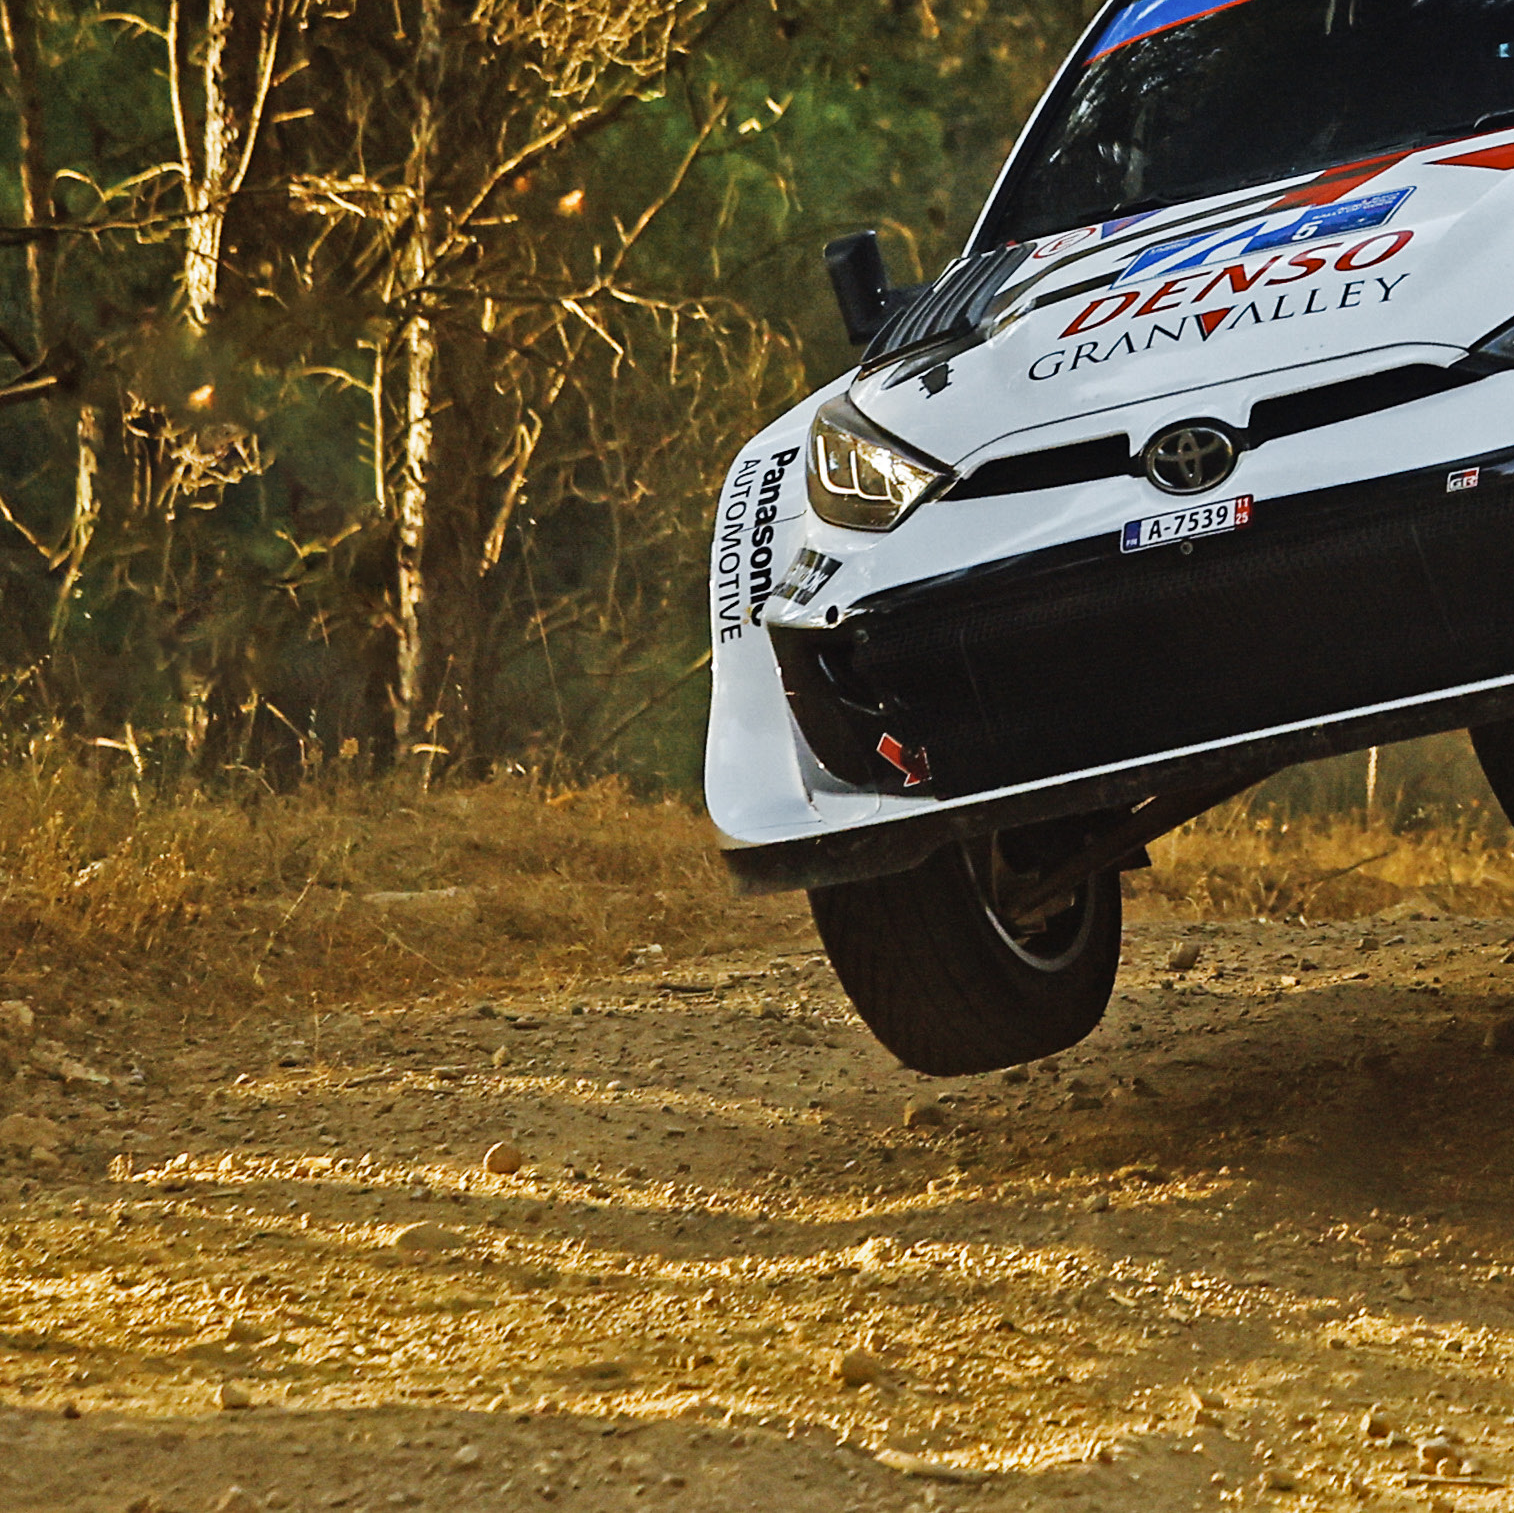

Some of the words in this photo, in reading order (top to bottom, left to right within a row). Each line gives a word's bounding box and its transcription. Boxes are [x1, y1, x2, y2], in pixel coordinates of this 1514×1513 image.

[1291, 219, 1323, 241] 5
[1057, 229, 1415, 340] DENSO
[1028, 272, 1412, 381] GRANVALLEY
[1235, 512, 1249, 525] 25
[1236, 498, 1249, 509] 11
[1148, 505, 1228, 541] A-7539
[718, 458, 761, 644] AUTOMOTIVE
